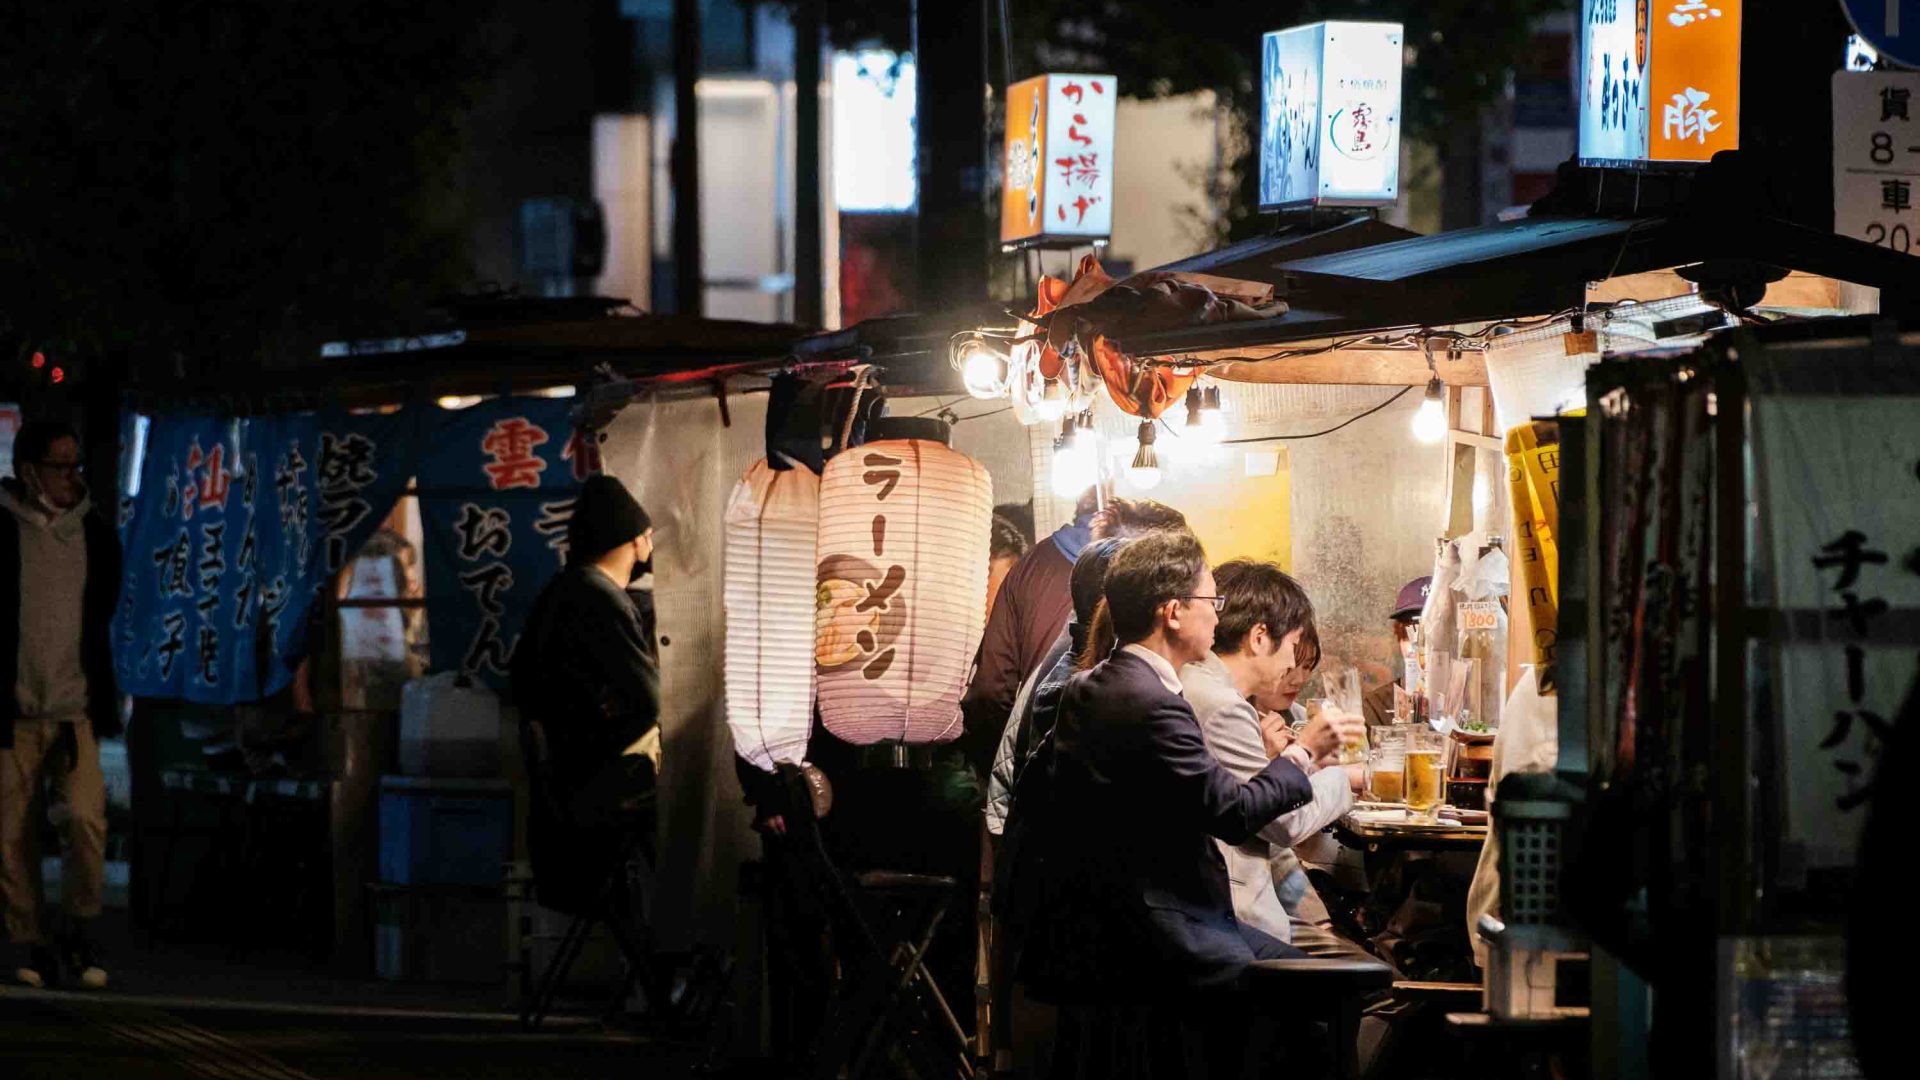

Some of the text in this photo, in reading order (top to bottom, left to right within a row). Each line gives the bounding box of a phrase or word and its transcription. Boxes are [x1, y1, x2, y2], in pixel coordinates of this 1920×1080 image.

[1054, 81, 1104, 227] から揚げ
[455, 503, 523, 677] おでん
[855, 453, 906, 681] ラーメン
[1811, 529, 1889, 812] チャーハン
